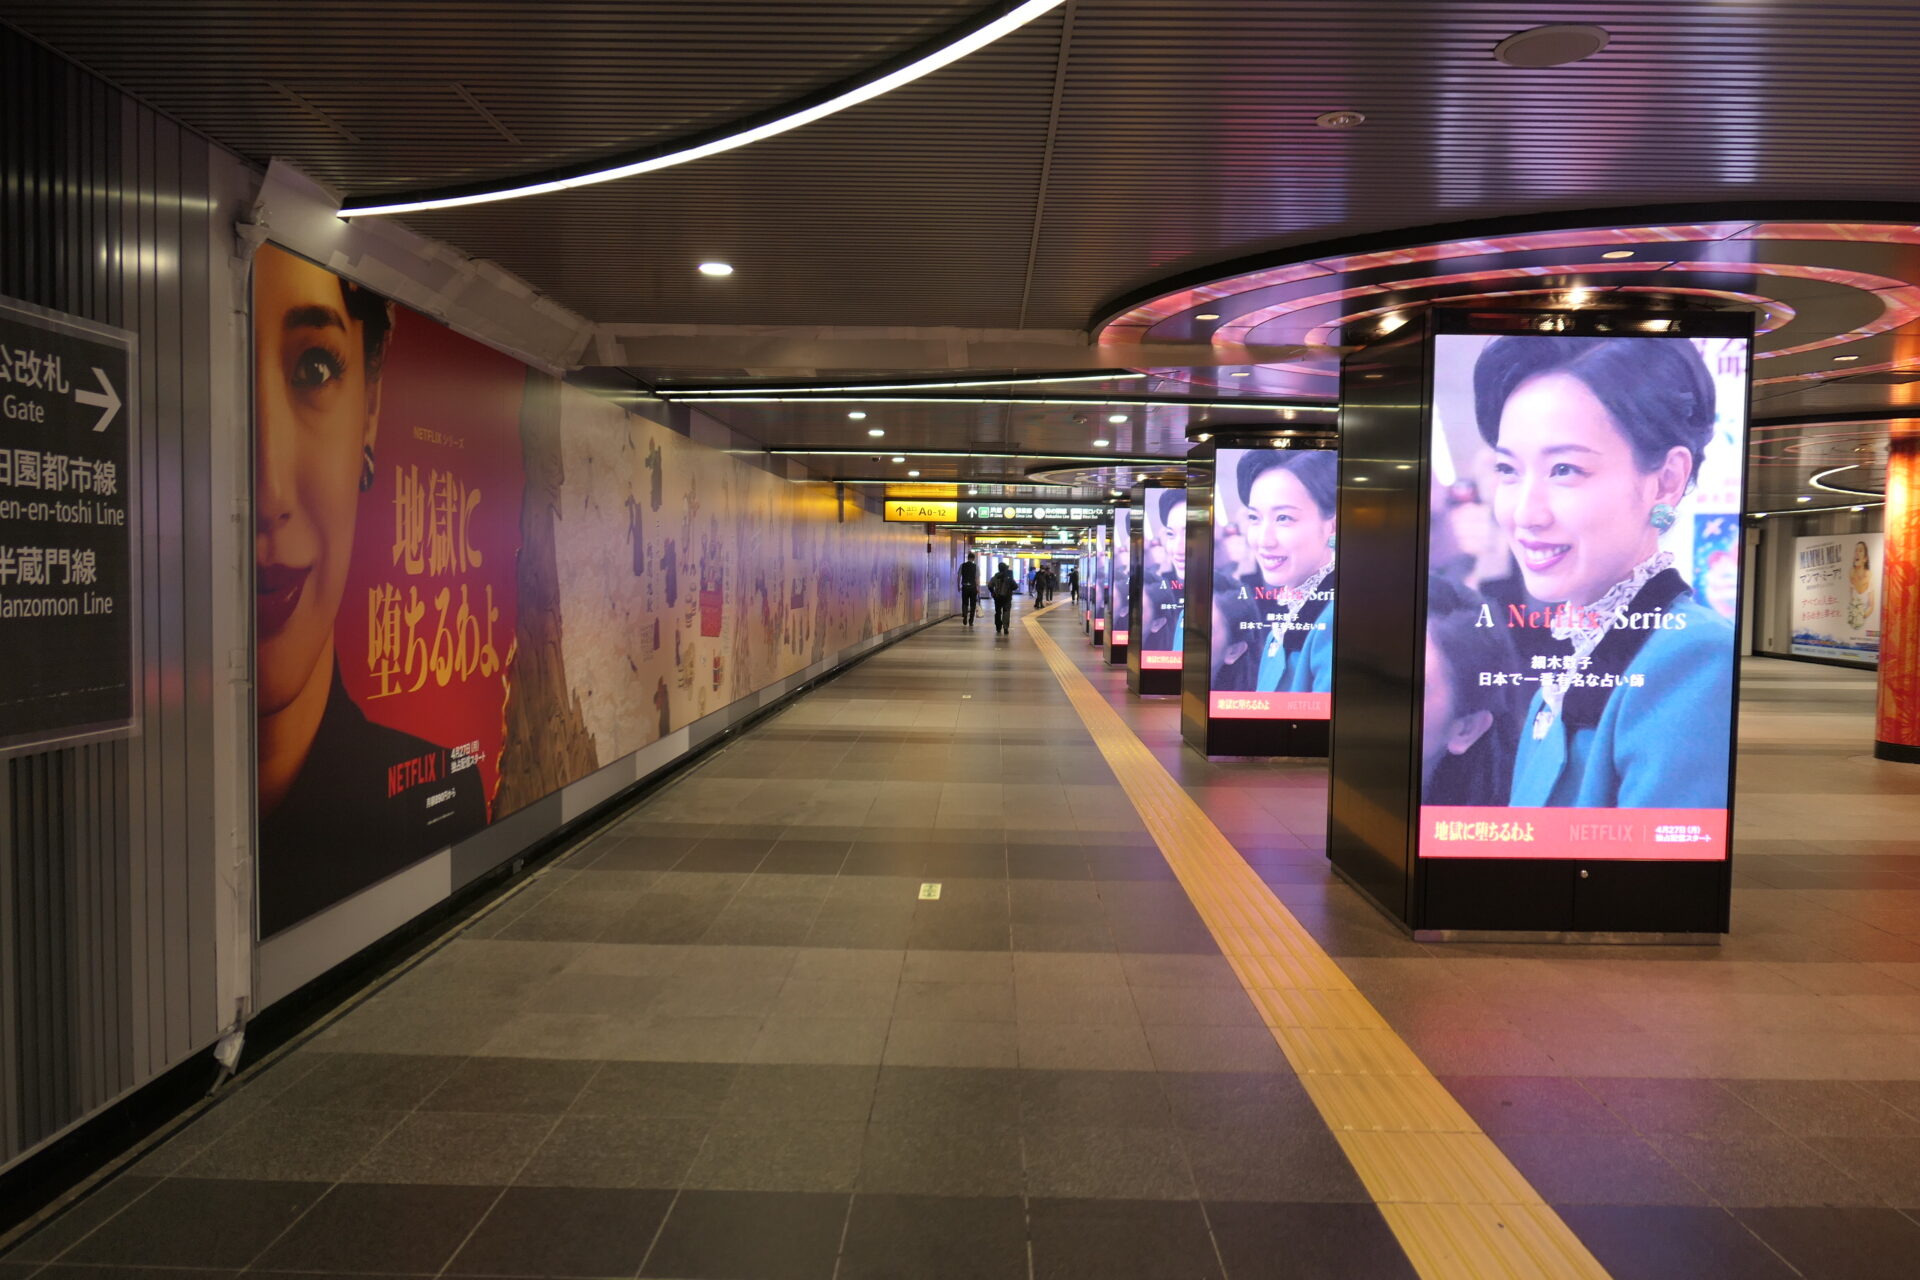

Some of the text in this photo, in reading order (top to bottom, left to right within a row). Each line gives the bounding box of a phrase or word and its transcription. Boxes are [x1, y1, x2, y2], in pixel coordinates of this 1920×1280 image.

[3, 394, 45, 424] Gate
[96, 502, 125, 527] Line
[391, 463, 483, 577] 地獄に
[1160, 580, 1168, 590] A
[1237, 586, 1248, 600] A
[0, 591, 113, 619] anzomon Line
[1475, 603, 1688, 630] A Netflix Series
[367, 582, 500, 700] 堕ちるわよ
[1479, 672, 1645, 688] 日本で一番有名な占い師
[388, 752, 437, 800] NETFLIX
[1434, 820, 1535, 842] 地獄に堕ちるわよ
[1569, 824, 1634, 842] NETFLIX
